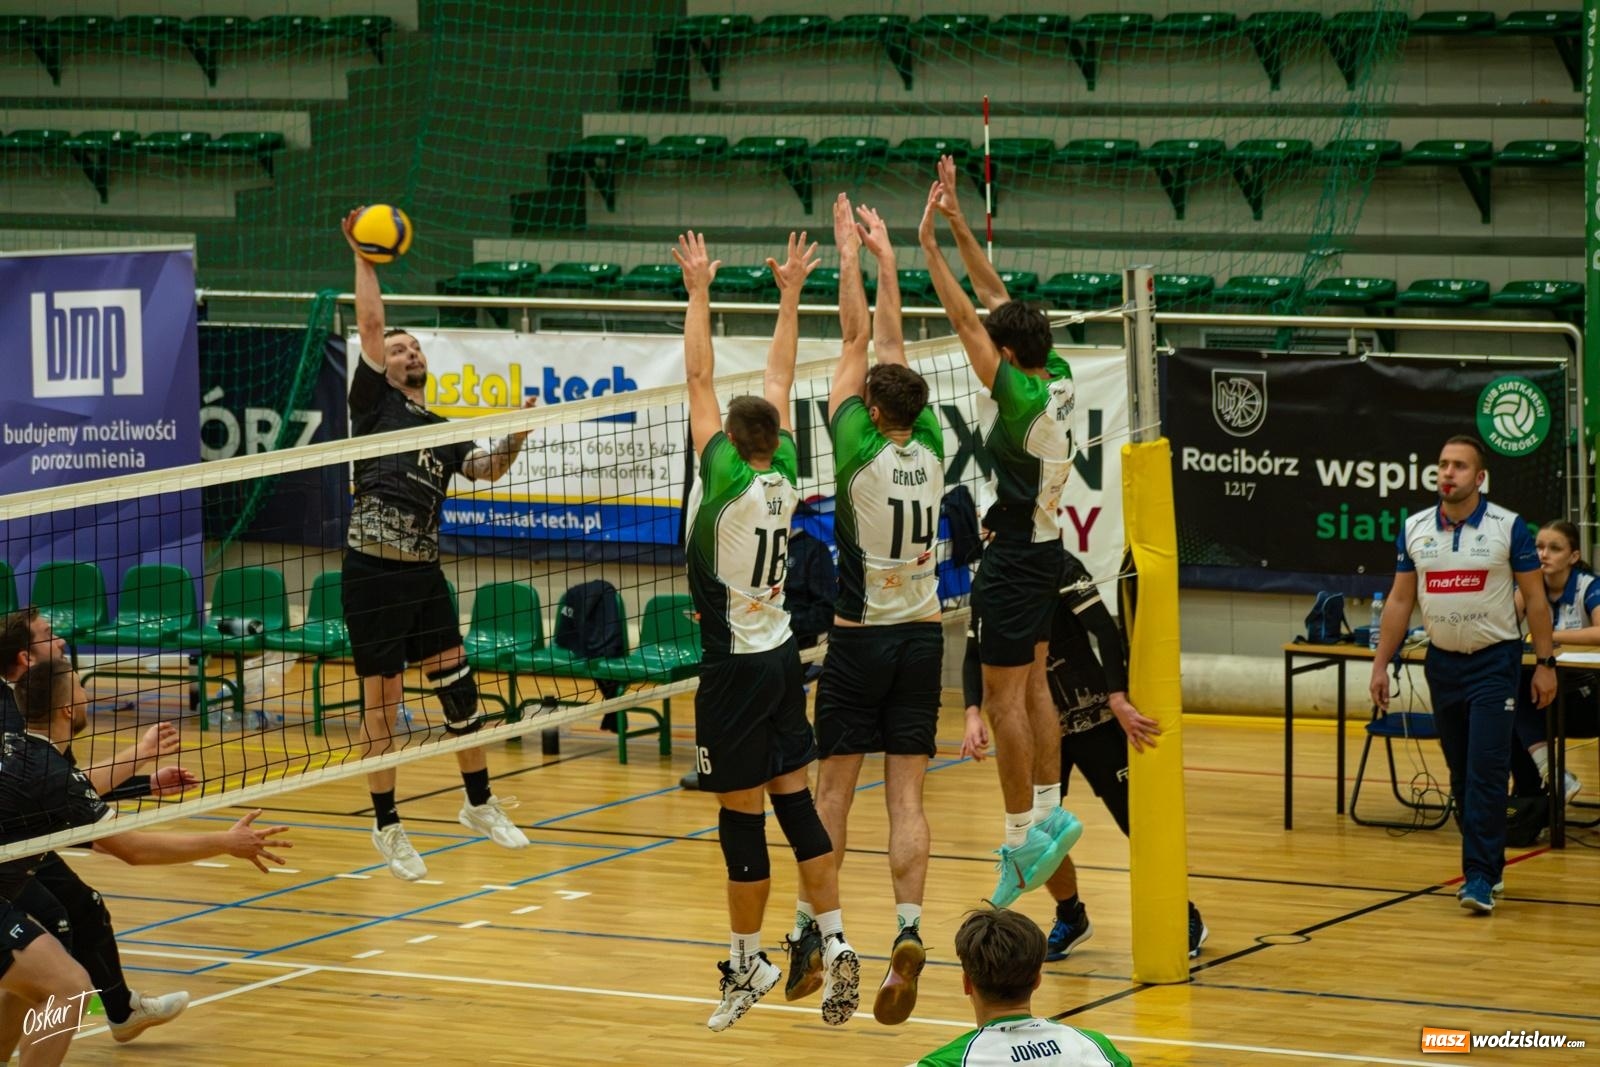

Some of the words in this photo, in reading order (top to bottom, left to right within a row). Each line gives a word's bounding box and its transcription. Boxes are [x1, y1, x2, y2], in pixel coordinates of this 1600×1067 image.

[40, 290, 136, 397] bmp
[1483, 388, 1499, 414] KLUB
[1498, 381, 1545, 417] SIATKARSKI
[3, 422, 78, 446] budujemy
[81, 418, 177, 442] możliwości
[1488, 431, 1539, 451] RACIBÓRZ
[31, 448, 146, 474] porozumienia
[659, 466, 669, 481] 2
[1181, 447, 1300, 477] Racibórz
[1224, 480, 1257, 502] 1217
[887, 496, 935, 560] 14
[751, 526, 788, 588] 16
[695, 745, 713, 776] 16
[1010, 1039, 1062, 1063] JOŃCA
